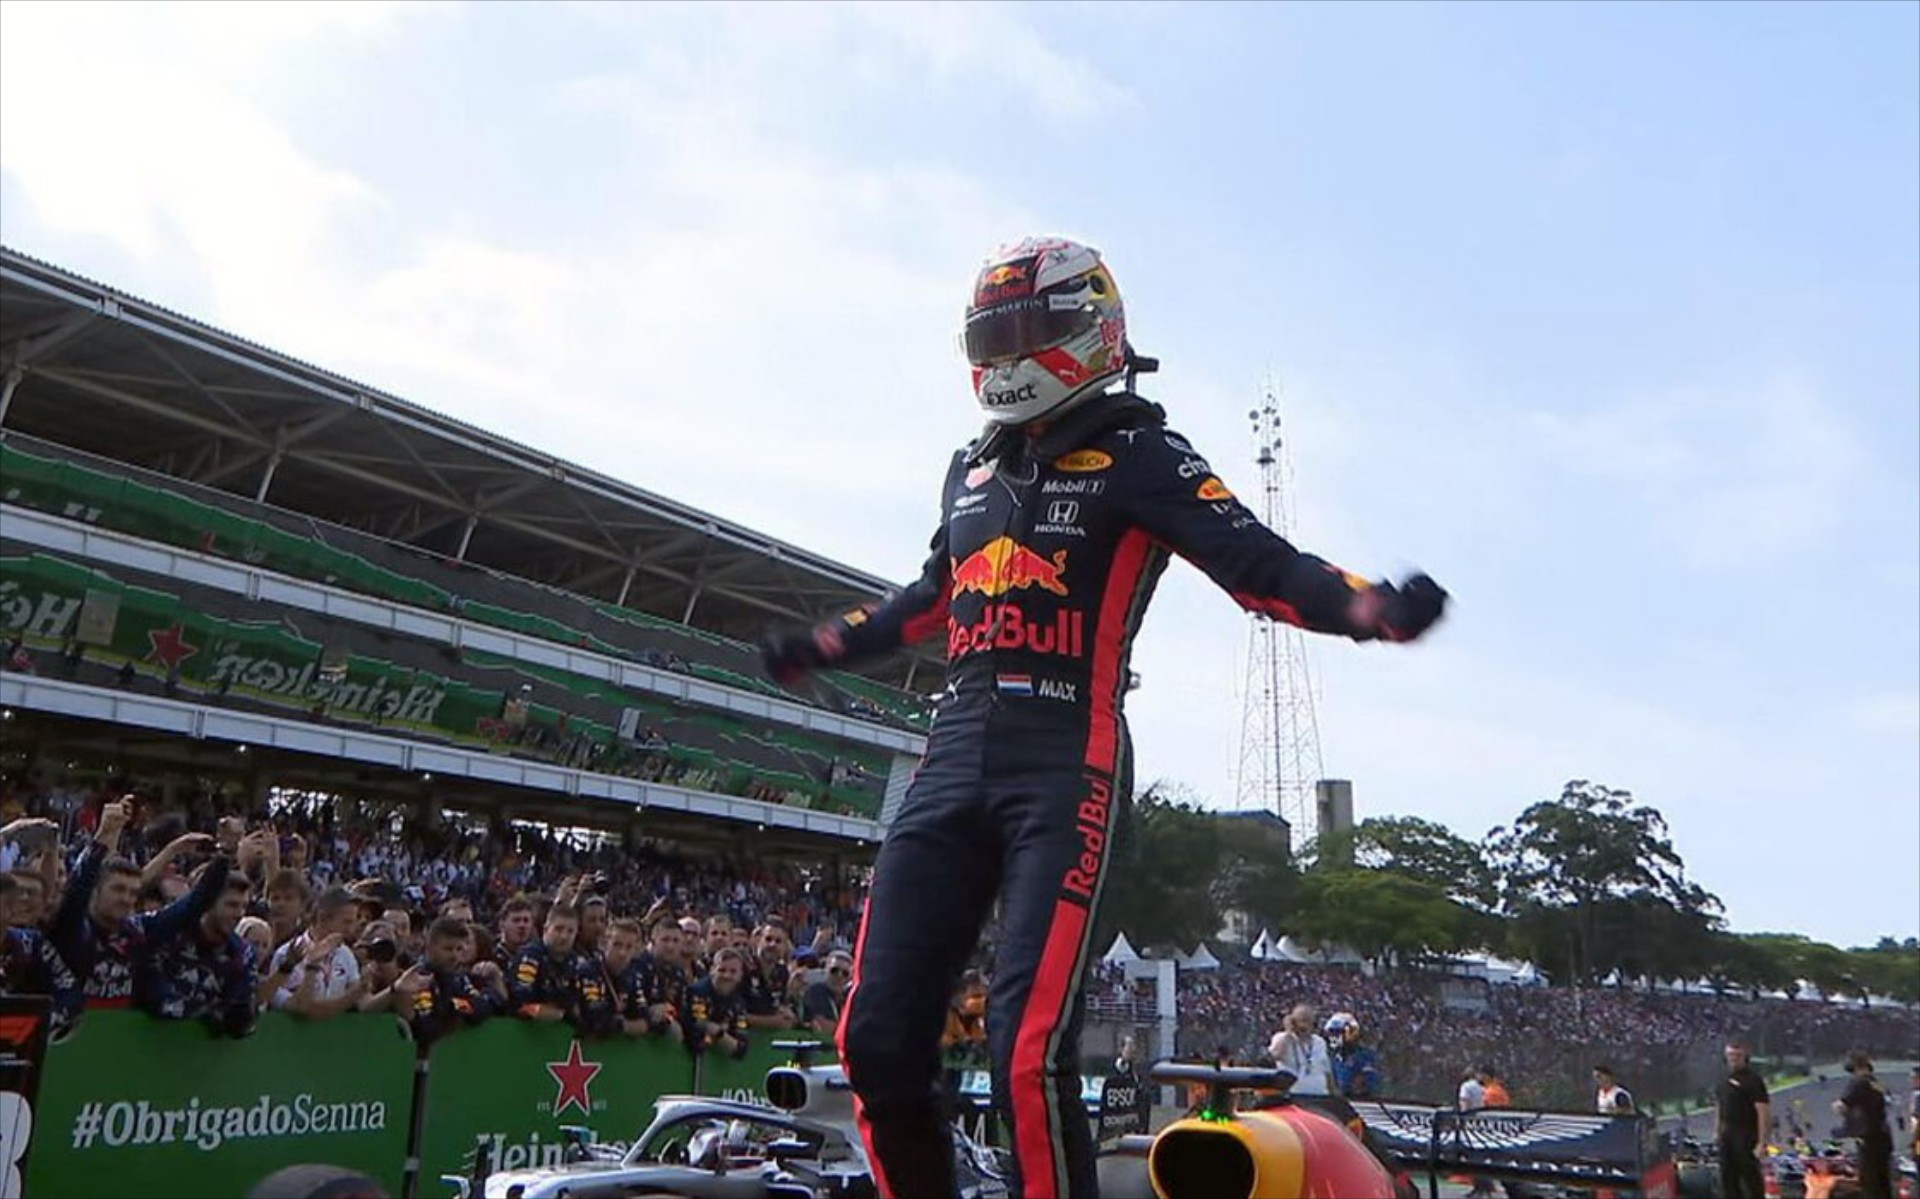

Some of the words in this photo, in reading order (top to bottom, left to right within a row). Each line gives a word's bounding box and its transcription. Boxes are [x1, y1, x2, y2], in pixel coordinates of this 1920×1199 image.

[987, 383, 1037, 406] exact
[1042, 481, 1085, 494] Mobil
[1034, 523, 1086, 537] HONDA
[1039, 678, 1076, 702] MAX
[72, 1094, 386, 1151] #ObrigadoSenna
